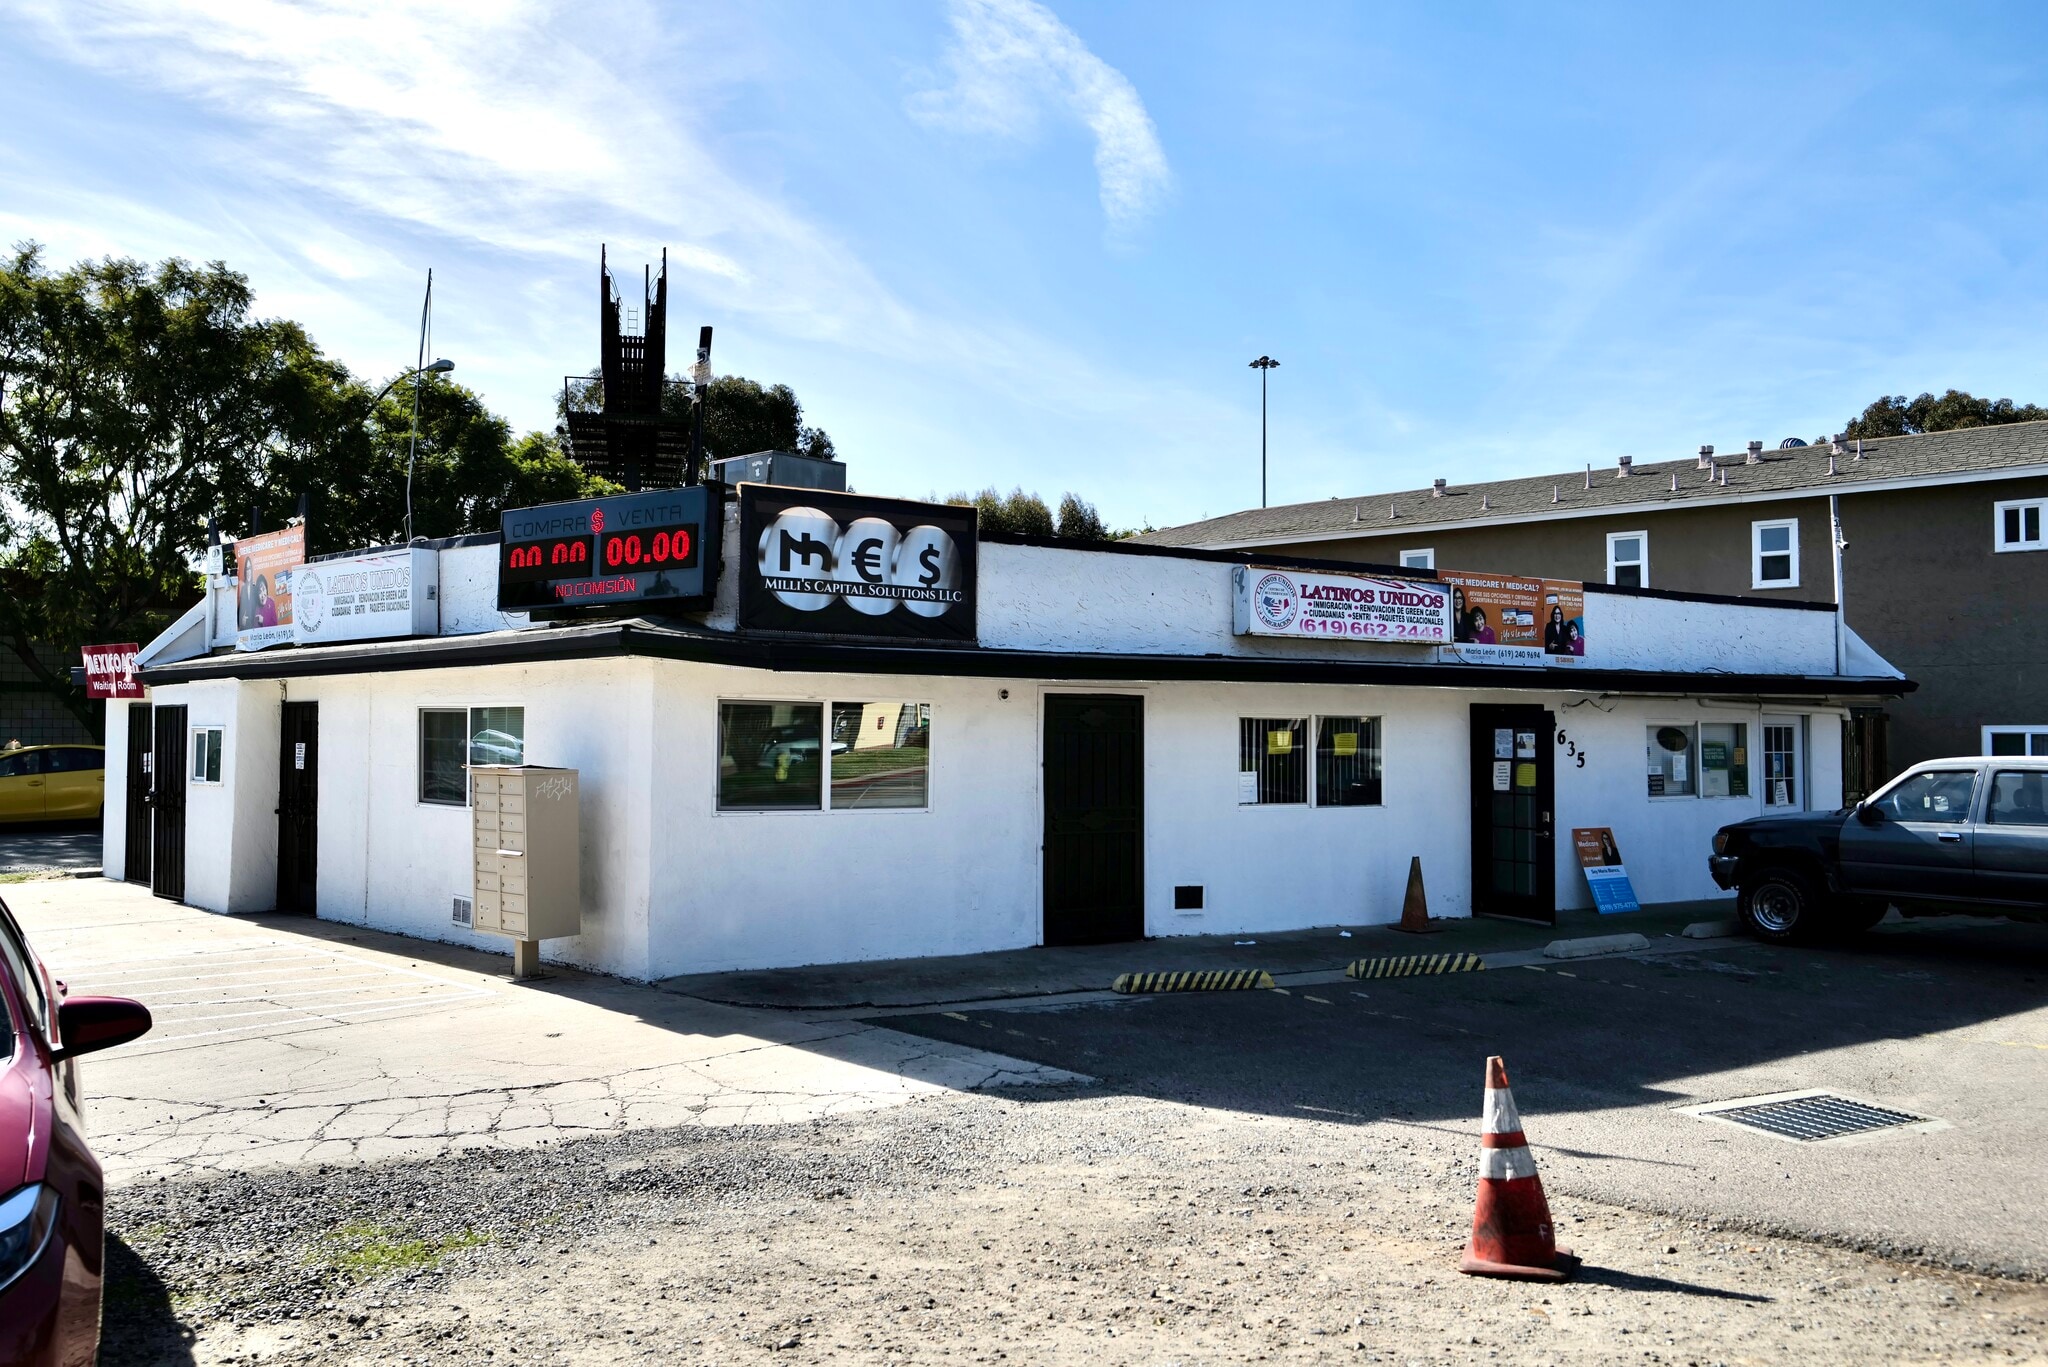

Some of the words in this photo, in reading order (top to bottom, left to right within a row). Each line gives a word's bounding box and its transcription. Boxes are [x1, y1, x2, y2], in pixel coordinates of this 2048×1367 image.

[512, 516, 586, 538] COMPRA
[618, 505, 682, 526] VENTA
[606, 530, 690, 567] 00.00
[327, 571, 368, 595] LATINOS
[370, 567, 410, 590] UNIDOS
[555, 584, 574, 597] NO
[575, 576, 637, 597] COMISIÓN
[1442, 577, 1464, 586] TIENE
[1466, 579, 1499, 588] MEDICARE
[1506, 582, 1540, 592] MEDI-CAL?
[938, 590, 962, 602] LLC
[1300, 584, 1375, 604] LATINOS
[1378, 590, 1444, 609] UNIDOS
[1309, 610, 1345, 619] CIUDADANIAS
[1352, 612, 1371, 620] SENTRI
[1379, 614, 1405, 623] PAQUETES
[1406, 616, 1444, 625] VACACIONALES
[1313, 601, 1353, 610] INMIGRACION
[1360, 604, 1395, 614] RENOVACION
[1397, 607, 1404, 615] DE
[1405, 608, 1424, 616] GREEN
[1425, 609, 1440, 617] CARD
[1299, 618, 1347, 635] (619)
[1350, 621, 1444, 639] 662-2448
[1483, 648, 1496, 656] León
[1498, 649, 1513, 659] (619)
[1515, 650, 1526, 659] 240
[1527, 651, 1540, 659] 9694
[117, 680, 137, 690] Room
